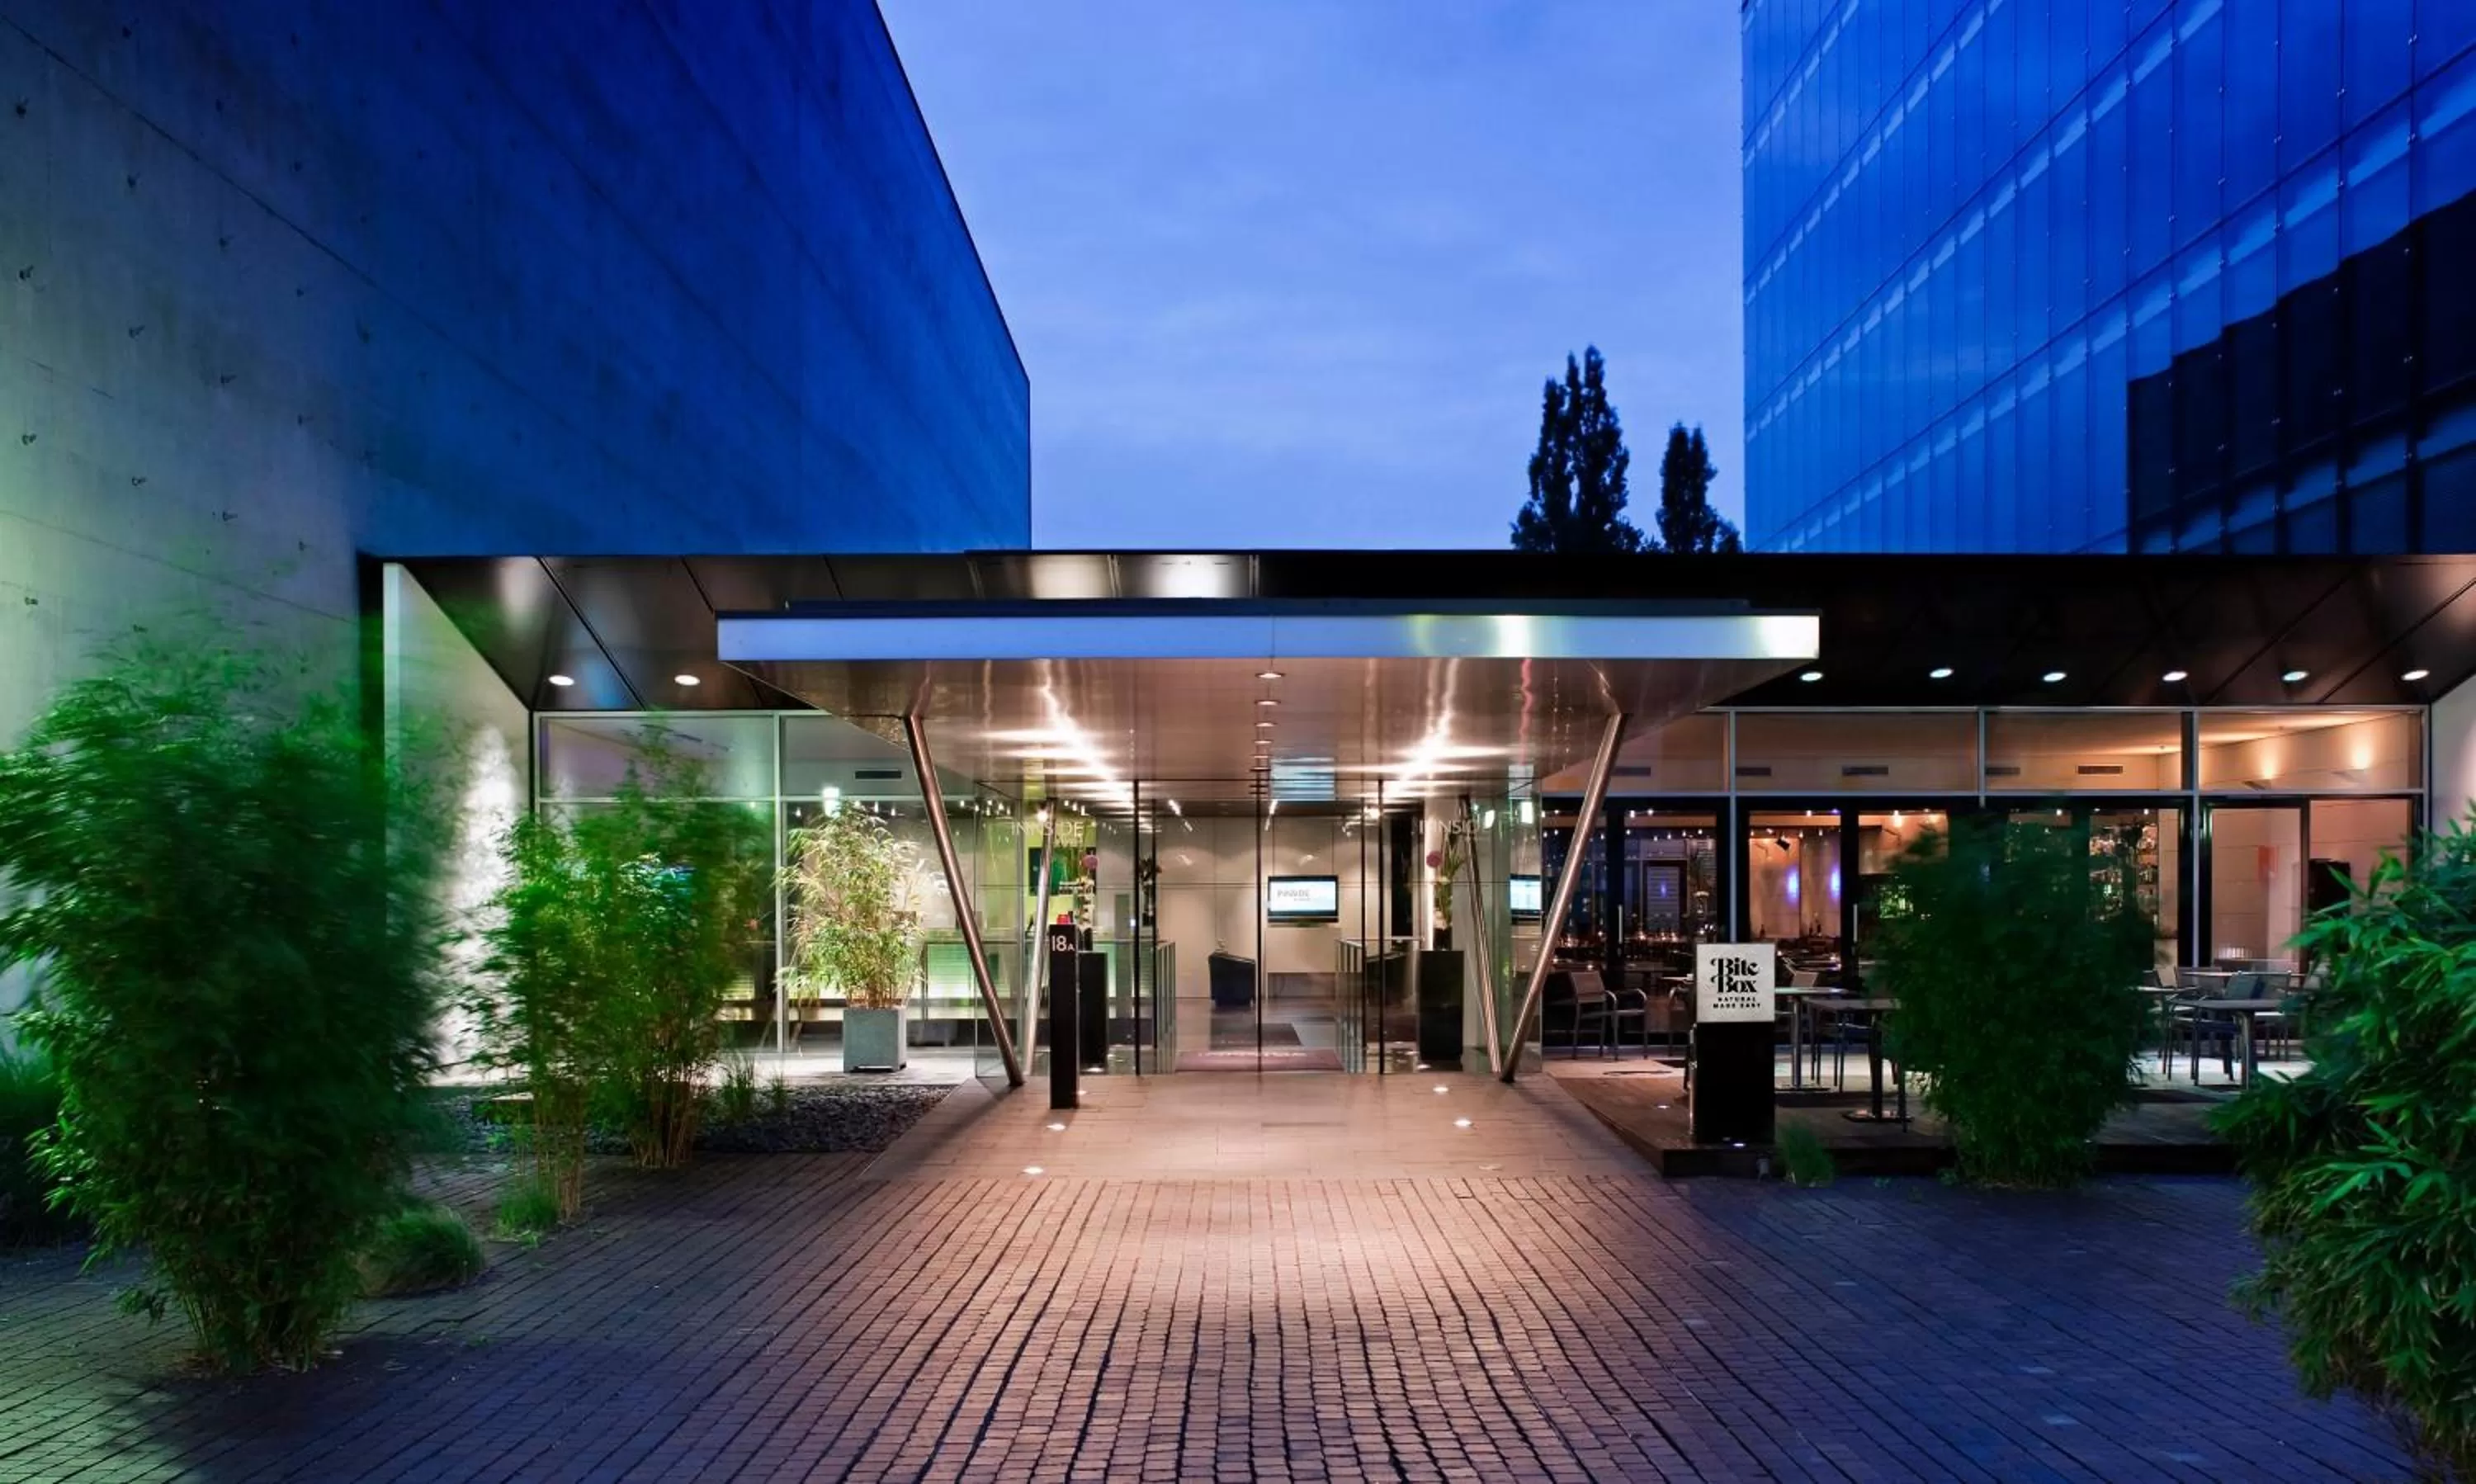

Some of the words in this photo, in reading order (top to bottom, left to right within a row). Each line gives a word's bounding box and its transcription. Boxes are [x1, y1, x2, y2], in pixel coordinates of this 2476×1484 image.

[1011, 820, 1084, 837] INNSDE
[1710, 957, 1760, 976] Bite
[1710, 975, 1757, 993] Box
